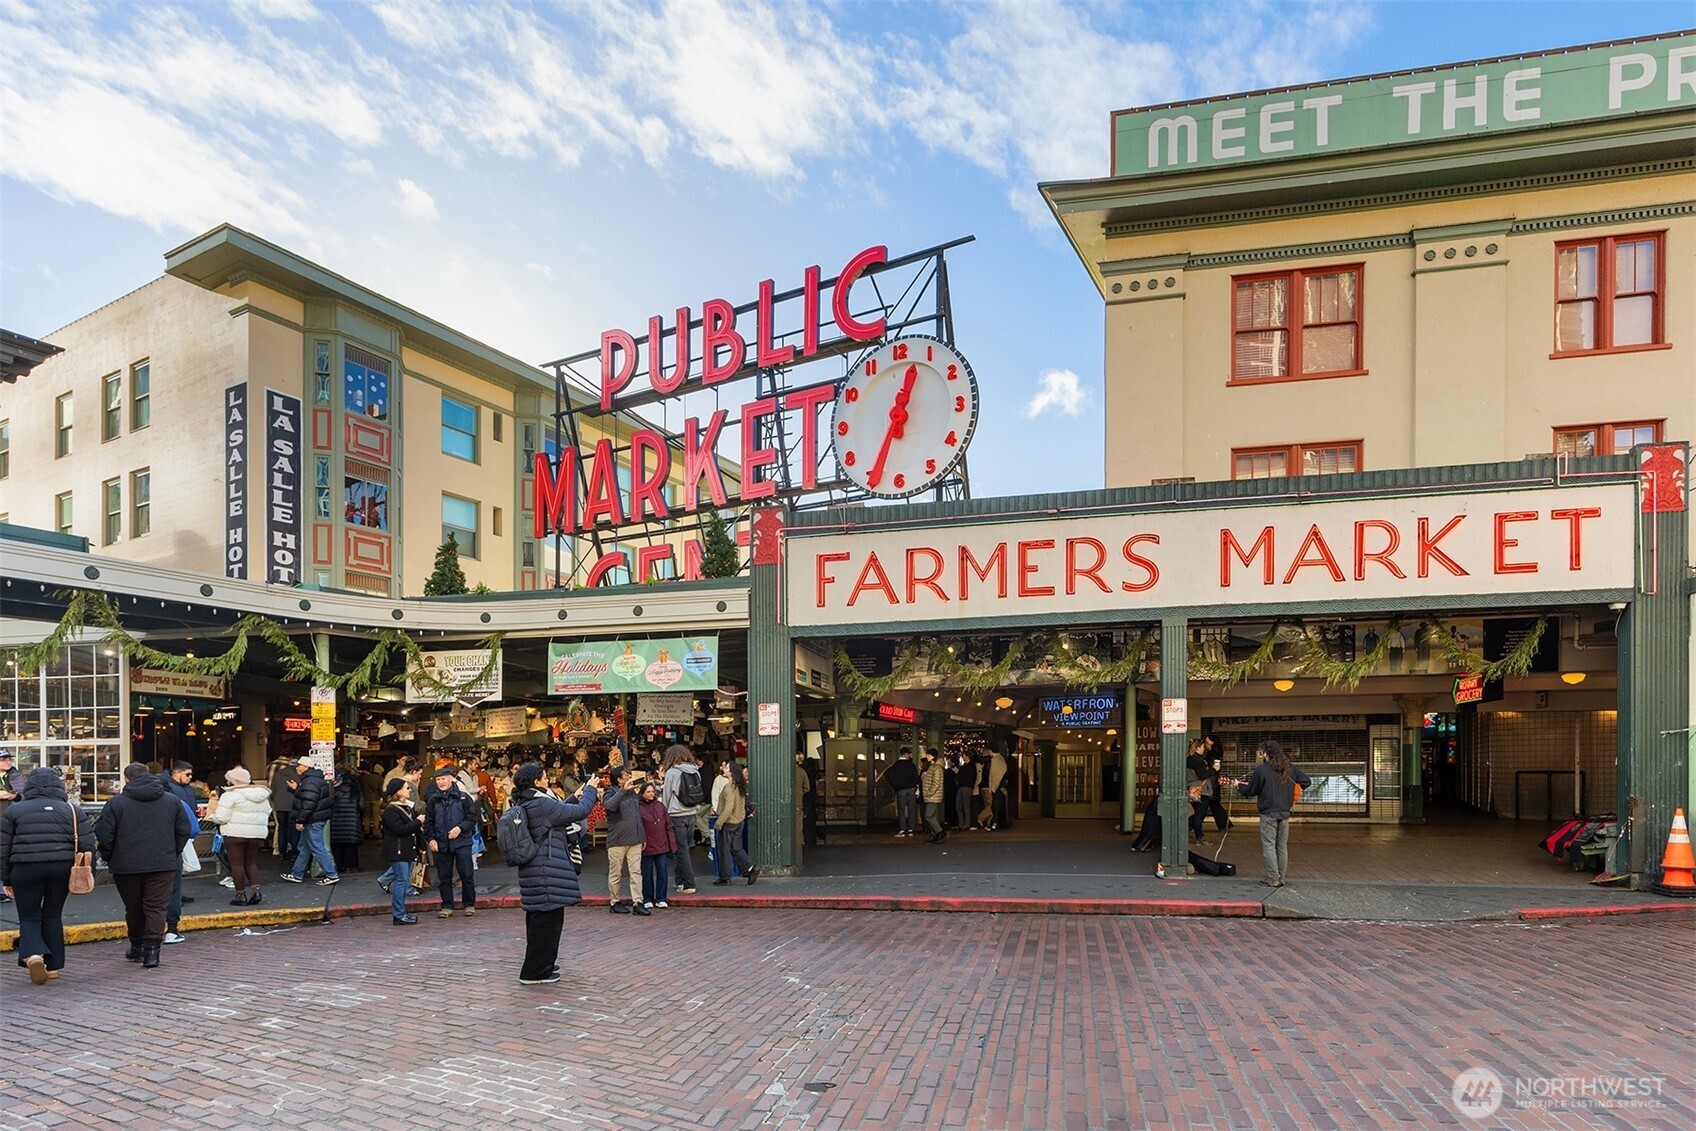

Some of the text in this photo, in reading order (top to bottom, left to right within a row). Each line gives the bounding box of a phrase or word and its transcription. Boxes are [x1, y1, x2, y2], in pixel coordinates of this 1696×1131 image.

[1148, 95, 1343, 169] MEET
[1392, 66, 1542, 134] THE
[600, 245, 888, 411] PUBLIC
[893, 343, 908, 361] 12
[927, 345, 933, 361] 1
[865, 359, 877, 376] 11
[947, 364, 958, 380] 2
[845, 387, 858, 403] 10
[228, 390, 243, 425] LA
[954, 395, 965, 412] 3
[837, 421, 849, 436] 9
[944, 430, 957, 446] 4
[534, 383, 838, 539] MARKET
[844, 451, 856, 466] 8
[925, 458, 936, 474] 5
[228, 429, 243, 518] SALLE
[893, 473, 905, 488] 6
[271, 395, 296, 586] LA SALLE HOT
[816, 533, 1160, 608] FARMERS
[1220, 506, 1601, 588] MARKET
[444, 654, 490, 668] YOUR CHAN
[550, 660, 608, 679] Holidays
[1456, 688, 1482, 701] GROCERY
[1053, 711, 1110, 722] VIEWPOINT
